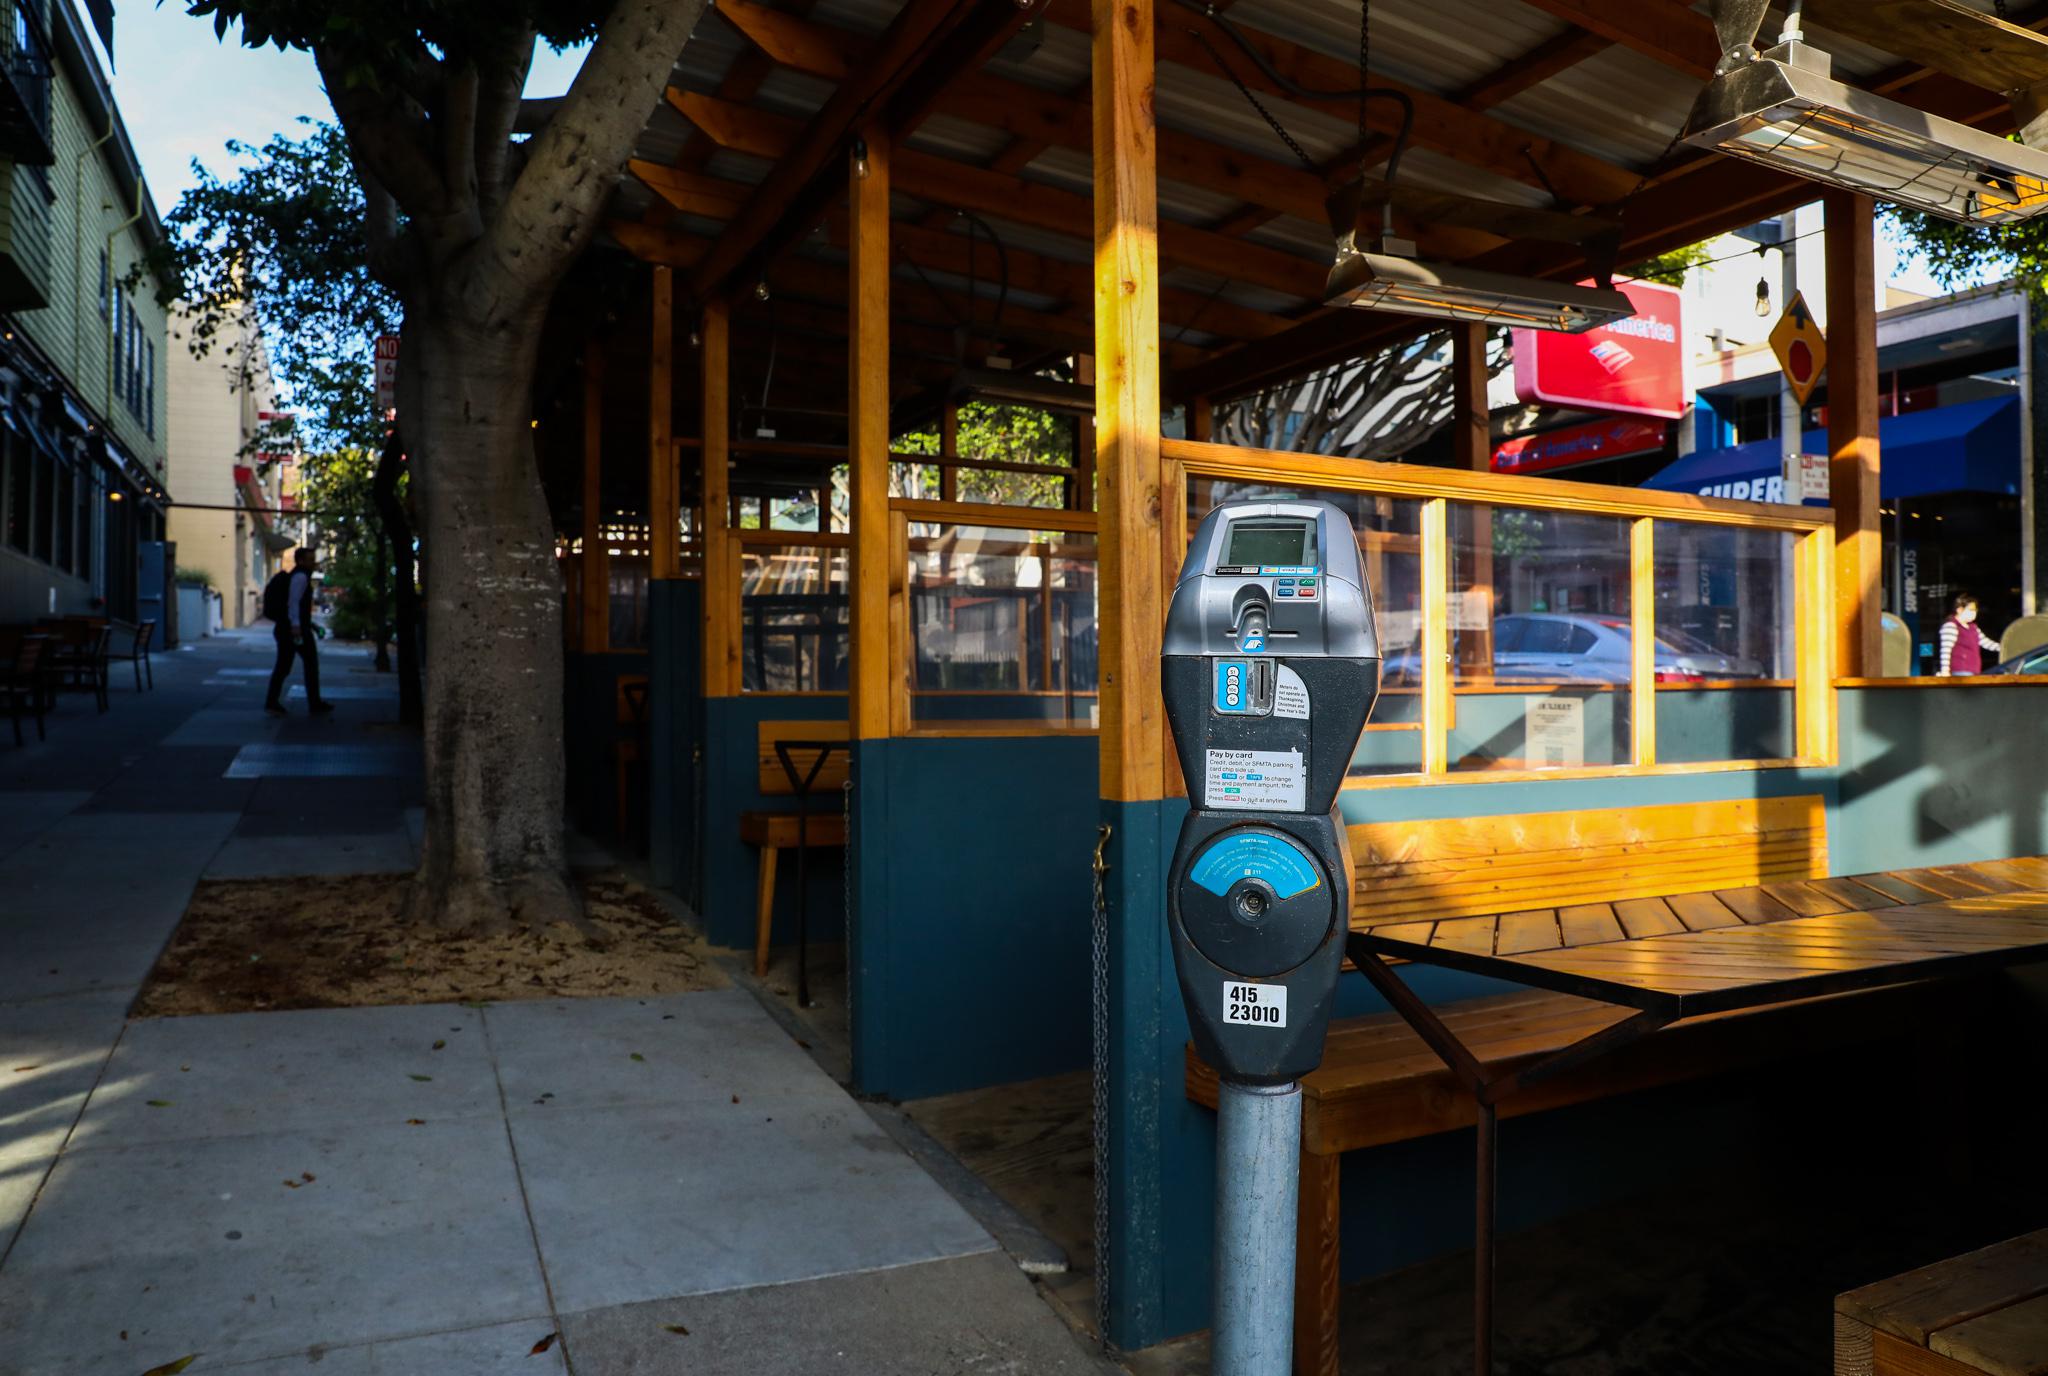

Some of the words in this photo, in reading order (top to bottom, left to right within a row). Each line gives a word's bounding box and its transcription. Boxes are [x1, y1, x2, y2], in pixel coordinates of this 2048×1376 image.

[1607, 315, 1676, 343] America
[378, 339, 398, 358] NO
[1903, 549, 1918, 613] SUPERCUTS
[1209, 750, 1224, 758] Pay
[1225, 751, 1234, 759] by
[1230, 986, 1258, 1003] 415
[1229, 1003, 1280, 1023] 23010
